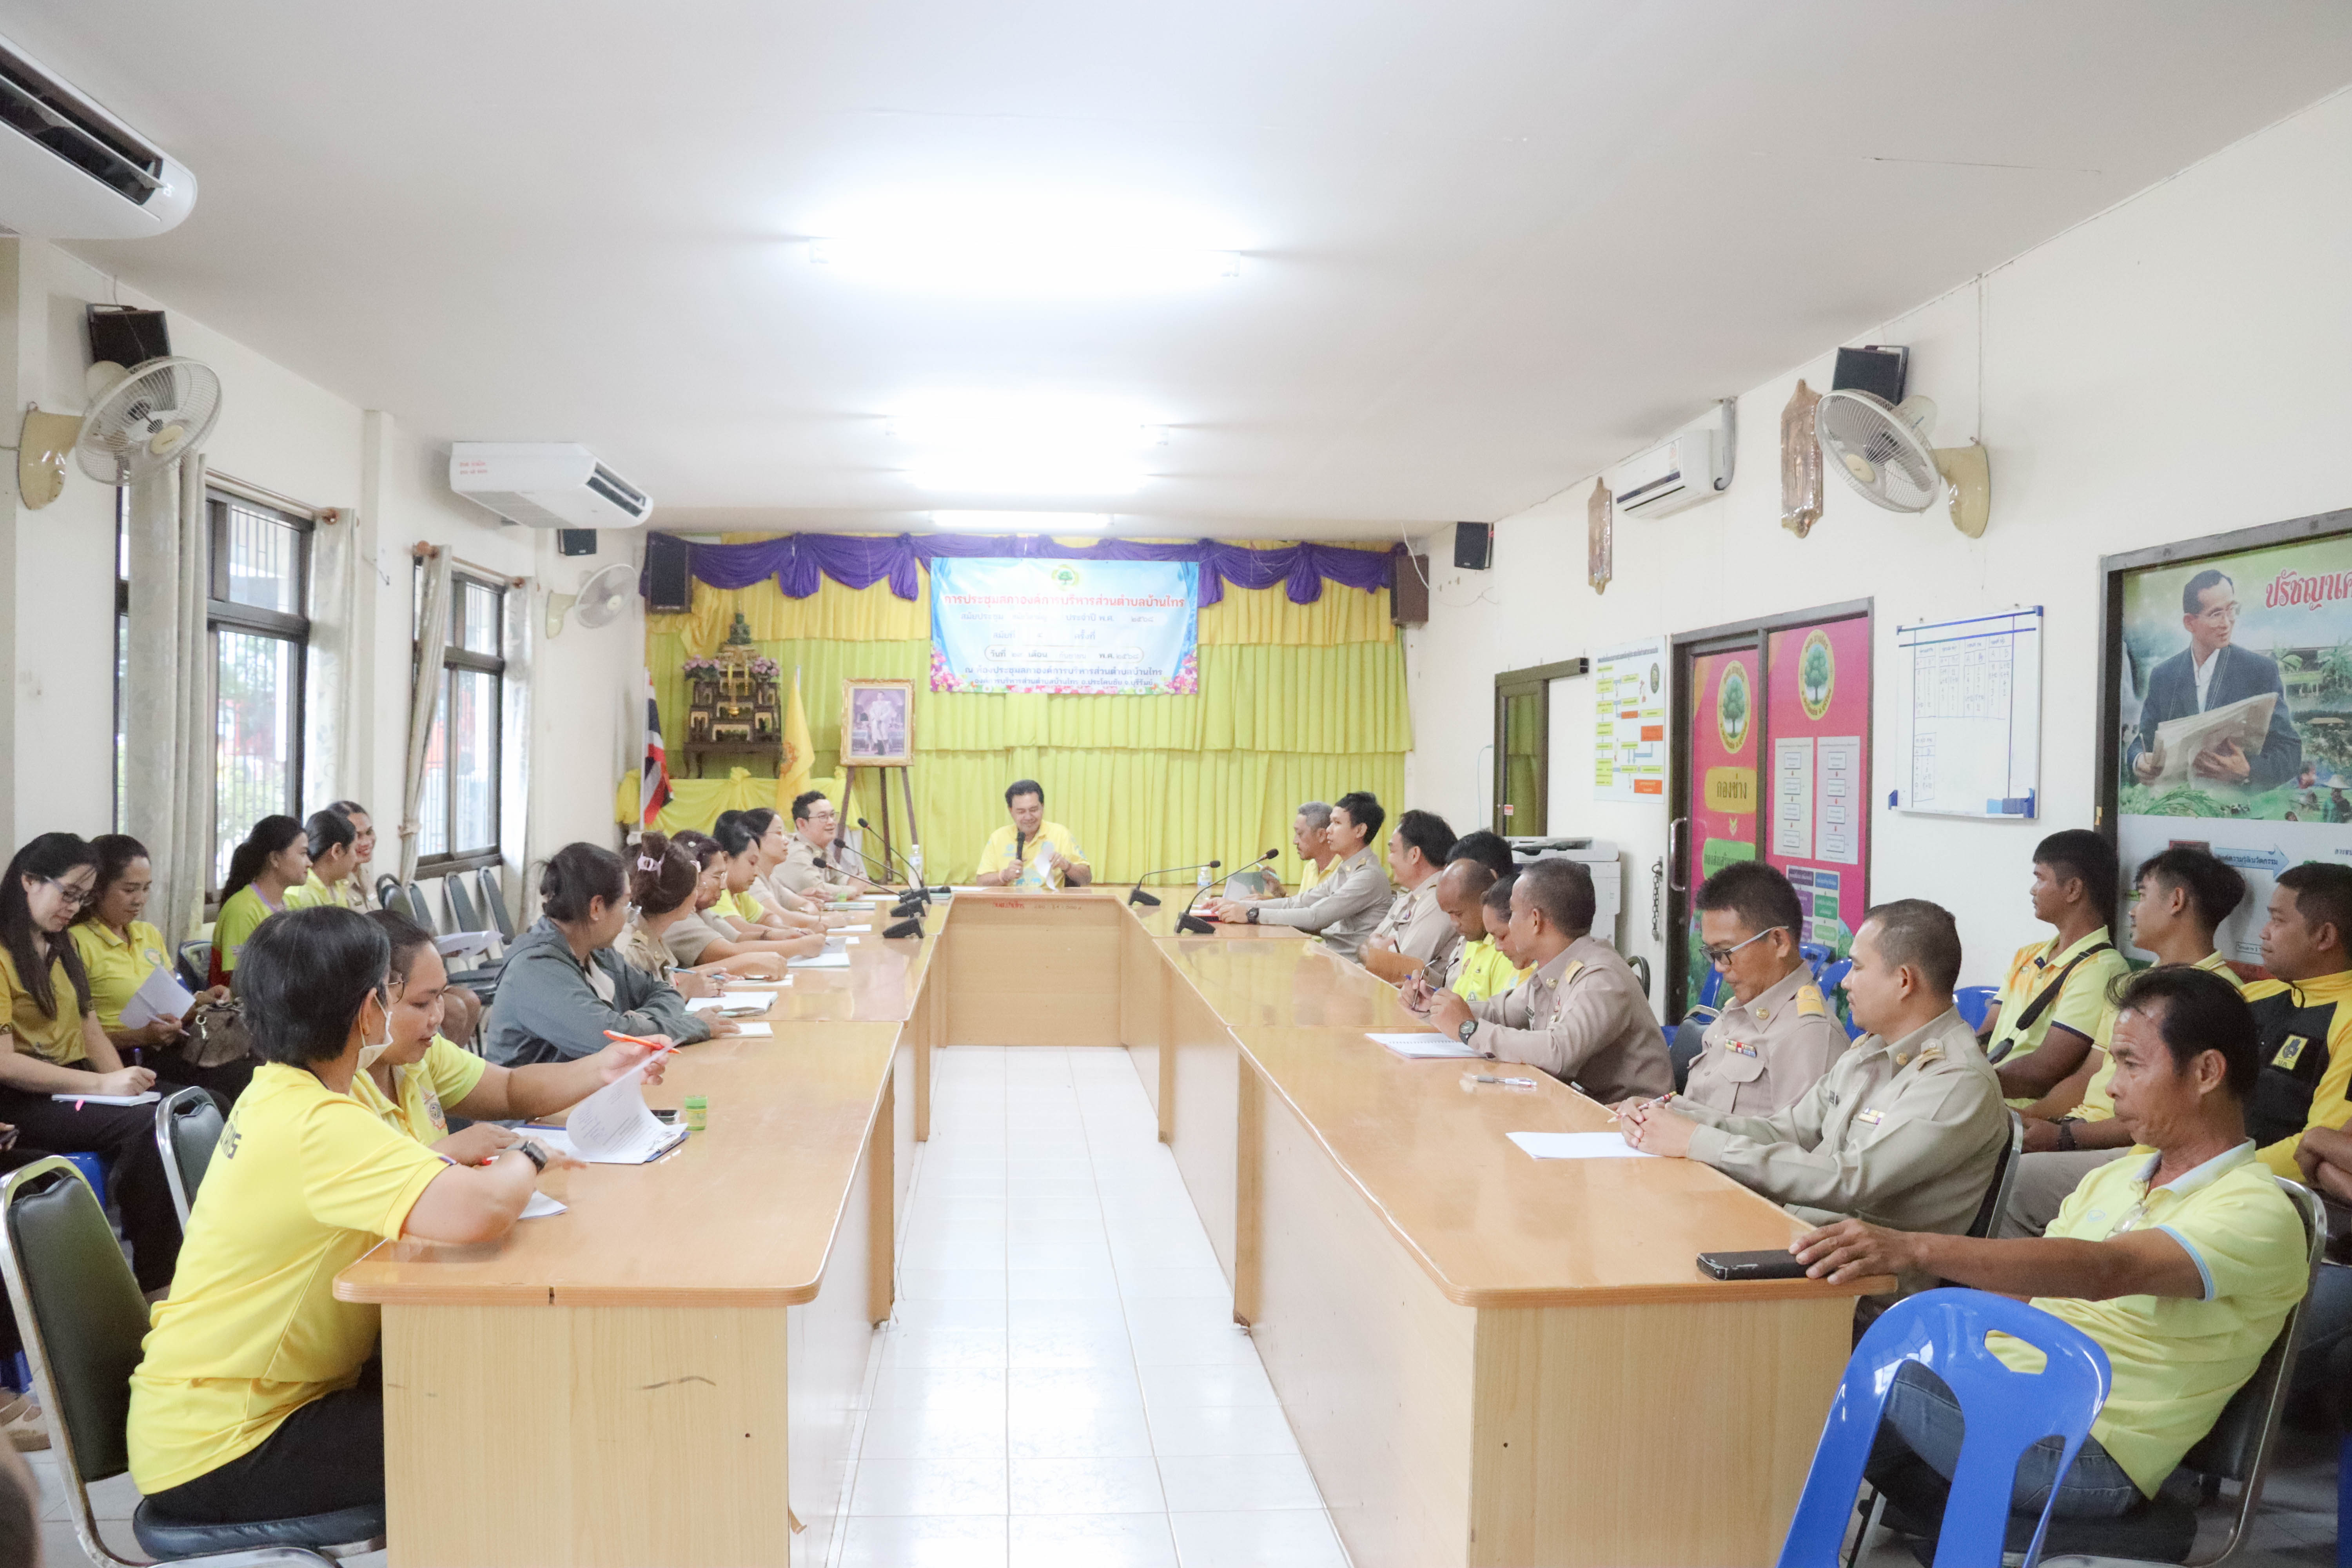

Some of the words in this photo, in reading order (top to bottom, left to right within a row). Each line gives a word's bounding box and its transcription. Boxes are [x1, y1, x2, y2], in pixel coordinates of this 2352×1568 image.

[944, 593, 1185, 608] การประชุมสภาองค์การบริหารส่วนตำบลบ้านไทร
[960, 612, 1004, 622] สมัยประชุม
[1066, 613, 1096, 622] ประจำปี
[993, 629, 1016, 639] สมัยที่
[1074, 629, 1096, 640] ครั้งที่
[990, 648, 1007, 658] วันที่
[1716, 773, 1748, 800] กองช่าง
